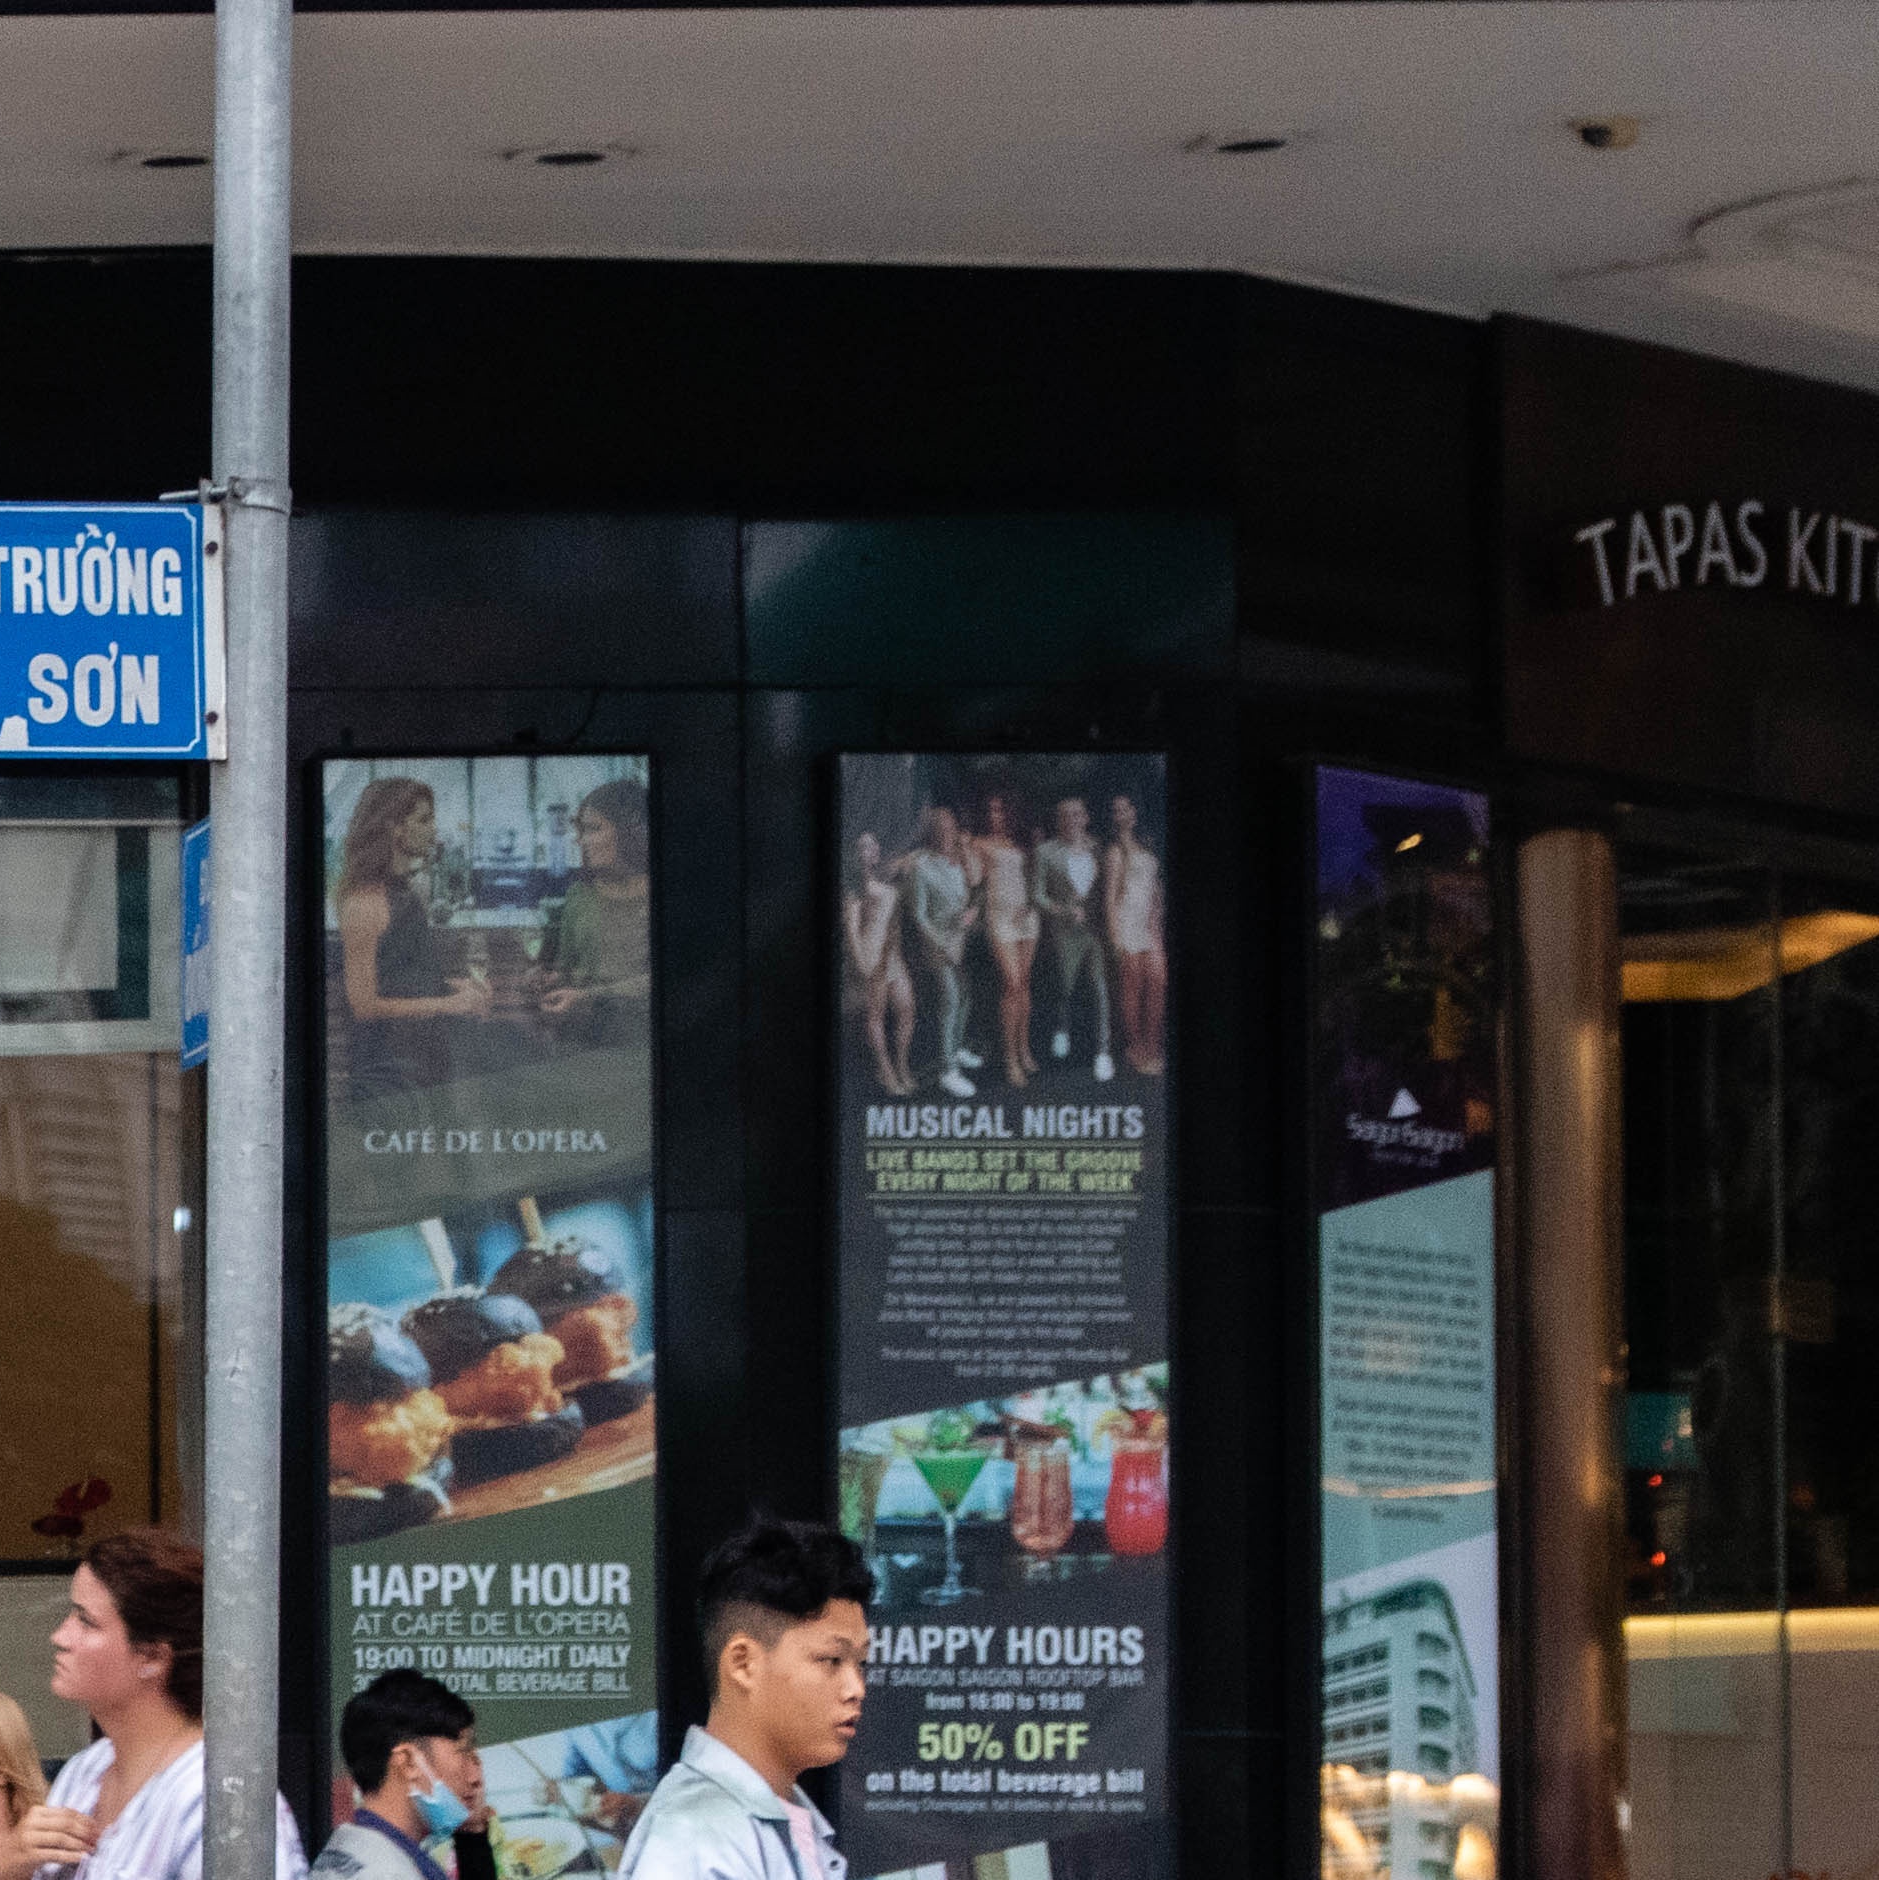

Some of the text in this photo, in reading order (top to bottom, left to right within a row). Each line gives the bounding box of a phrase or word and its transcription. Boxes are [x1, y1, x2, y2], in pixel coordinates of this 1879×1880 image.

[1573, 500, 1879, 607] TAPAS KIT
[27, 641, 160, 727] SƠN
[865, 1104, 1144, 1139] MUSICAL NIGHTS
[364, 1126, 436, 1153] CAFÉ
[444, 1129, 484, 1153] DE
[876, 1171, 938, 1192] EVERY
[941, 1171, 1002, 1192] NIGHT
[1077, 1171, 1134, 1192] WEEK
[350, 1562, 632, 1607] HAPPY HOUR
[352, 1609, 632, 1637] AT CAFÉ DE L'OPERA
[353, 1645, 632, 1670] 19:00 TO MIDNIGHT DAILY
[867, 1624, 1145, 1666] HAPPY HOURS
[495, 1672, 588, 1693] BEVERAGE
[592, 1672, 631, 1693] BILL
[917, 1722, 1090, 1762] 50% OFF
[865, 1768, 1145, 1798] on the total beverage bill
